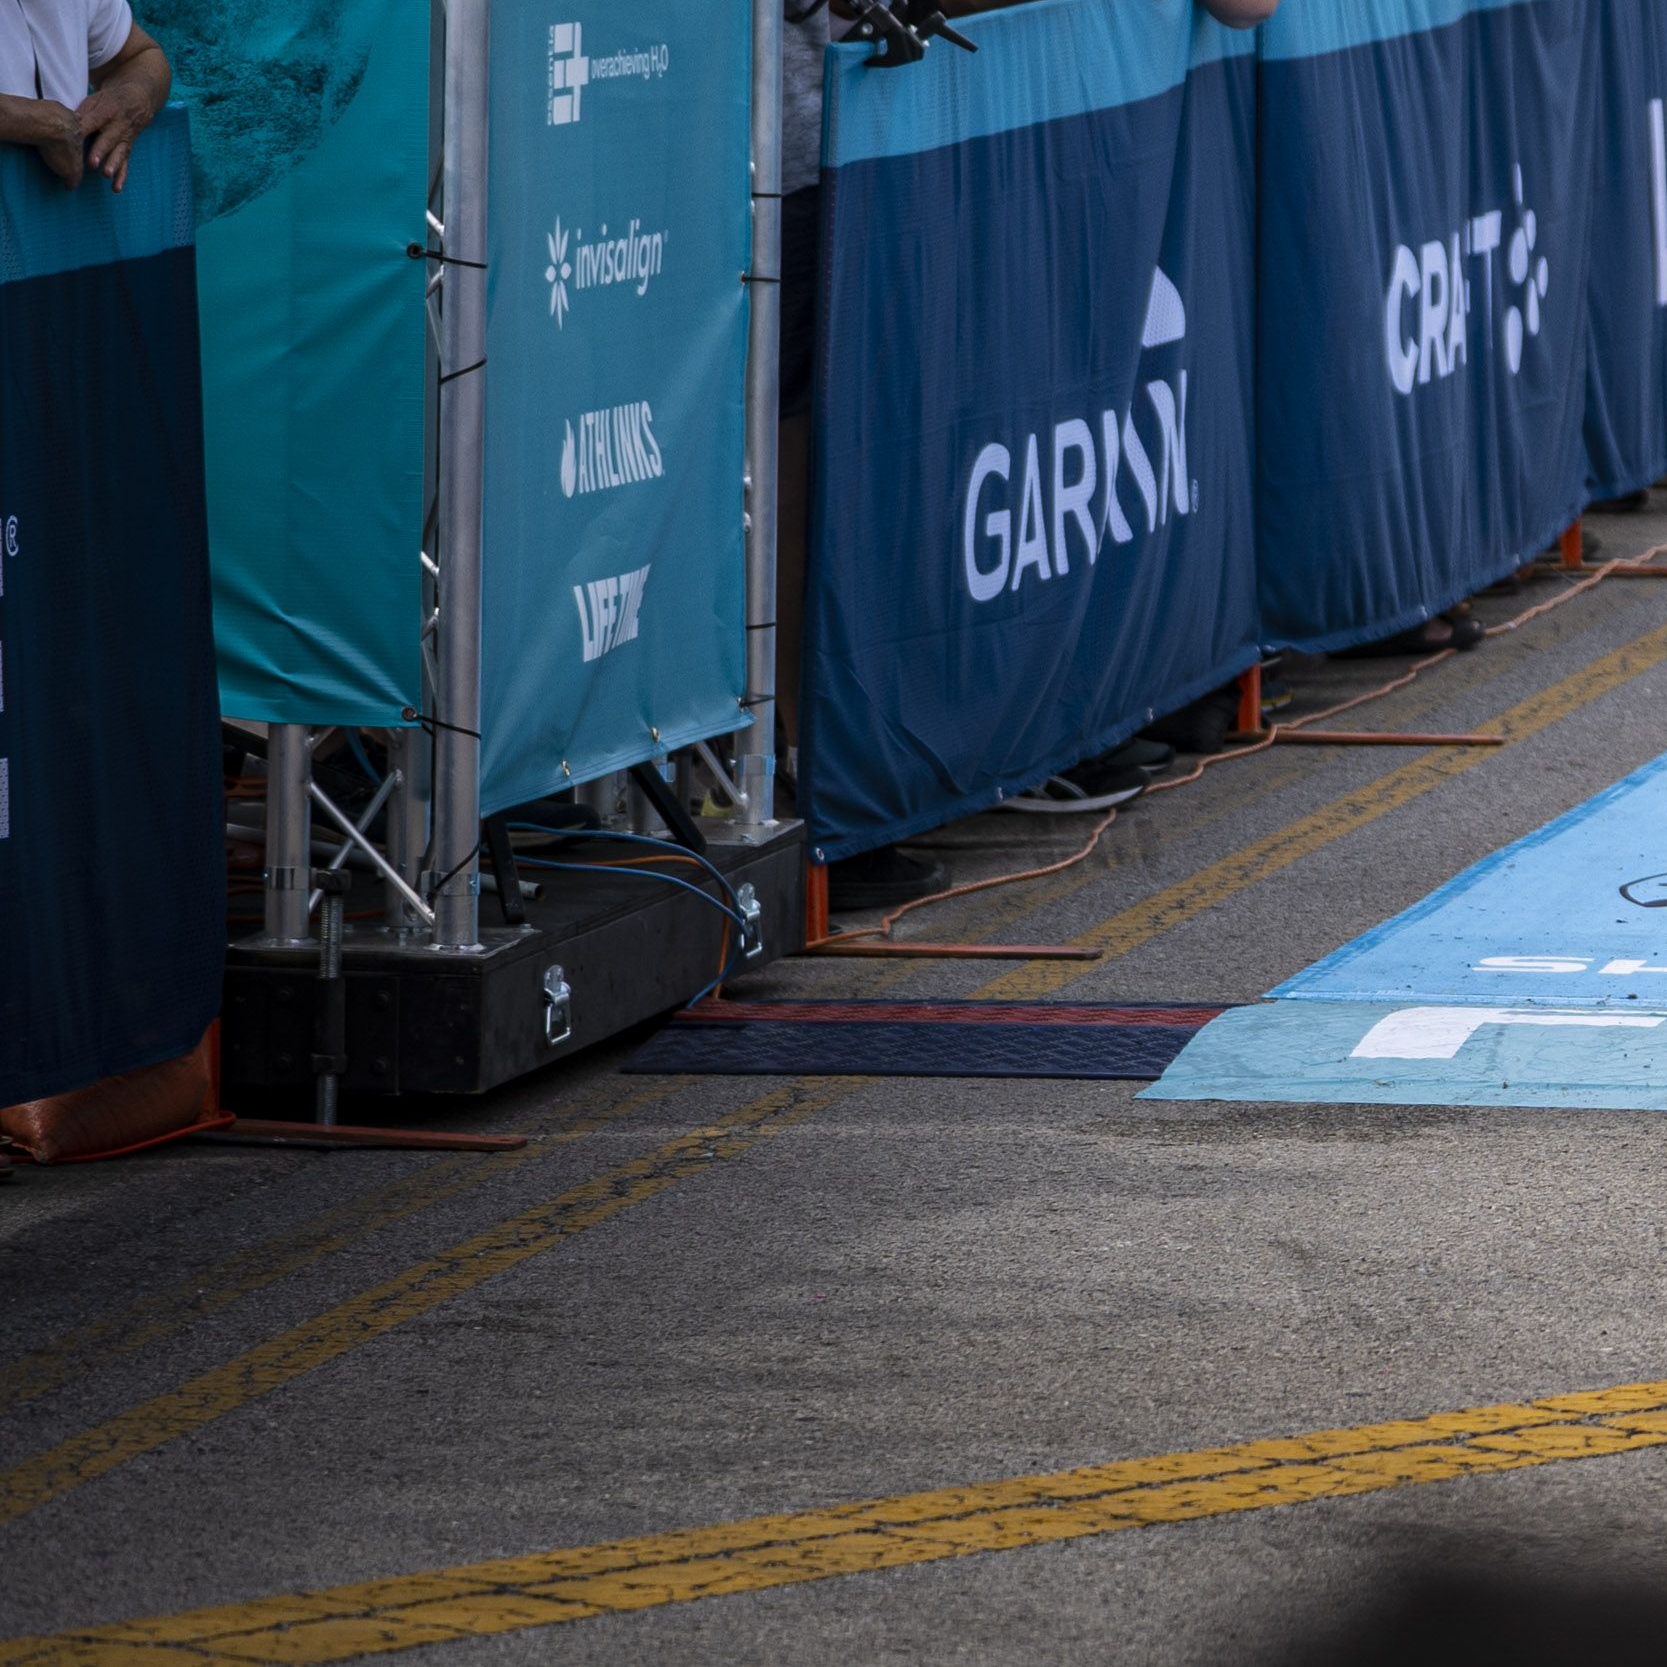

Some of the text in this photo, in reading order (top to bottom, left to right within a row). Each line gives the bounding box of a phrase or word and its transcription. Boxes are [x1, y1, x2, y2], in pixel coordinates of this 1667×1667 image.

[575, 218, 663, 297] invisalign
[1386, 209, 1502, 395] CRAT
[579, 400, 663, 495] ATHLINKS
